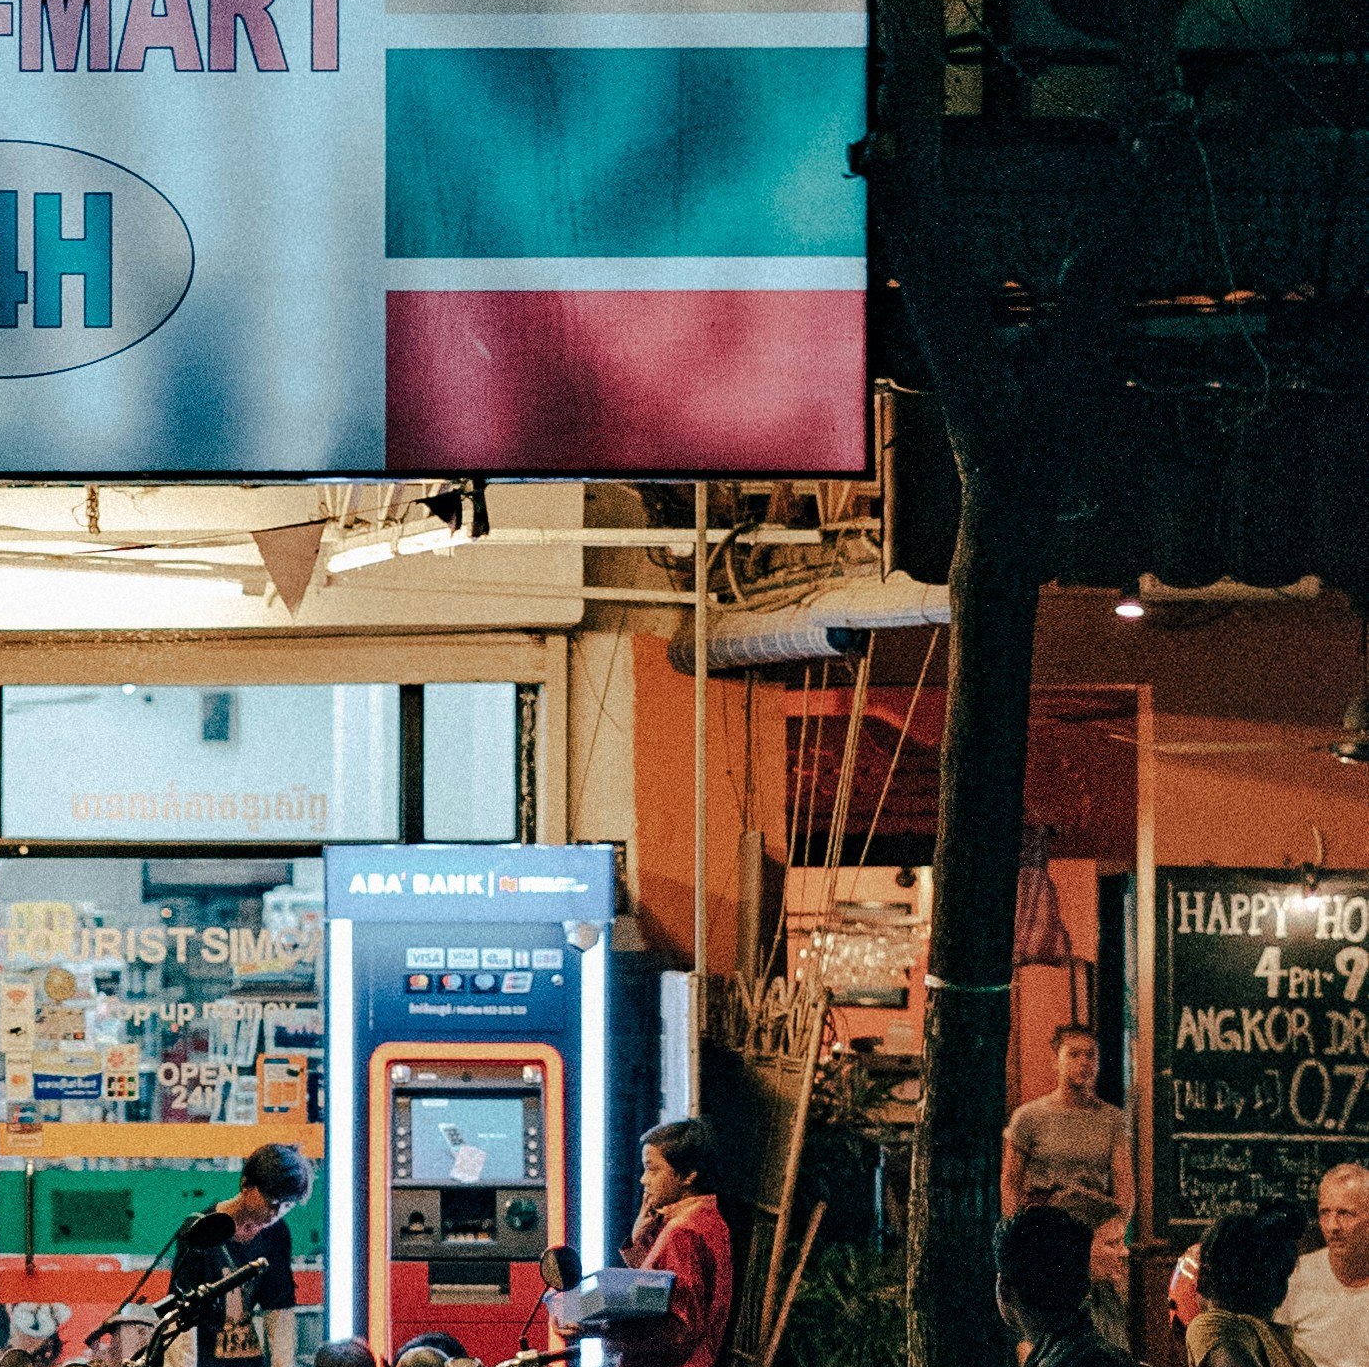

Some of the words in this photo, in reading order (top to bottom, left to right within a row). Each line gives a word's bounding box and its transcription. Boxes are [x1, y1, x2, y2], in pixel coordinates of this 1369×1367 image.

[413, 873, 484, 894] BANK
[1177, 892, 1290, 939] HAPPY
[159, 1004, 194, 1026] up
[1176, 1005, 1314, 1054] ANGKOR
[158, 1062, 239, 1087] OPEN
